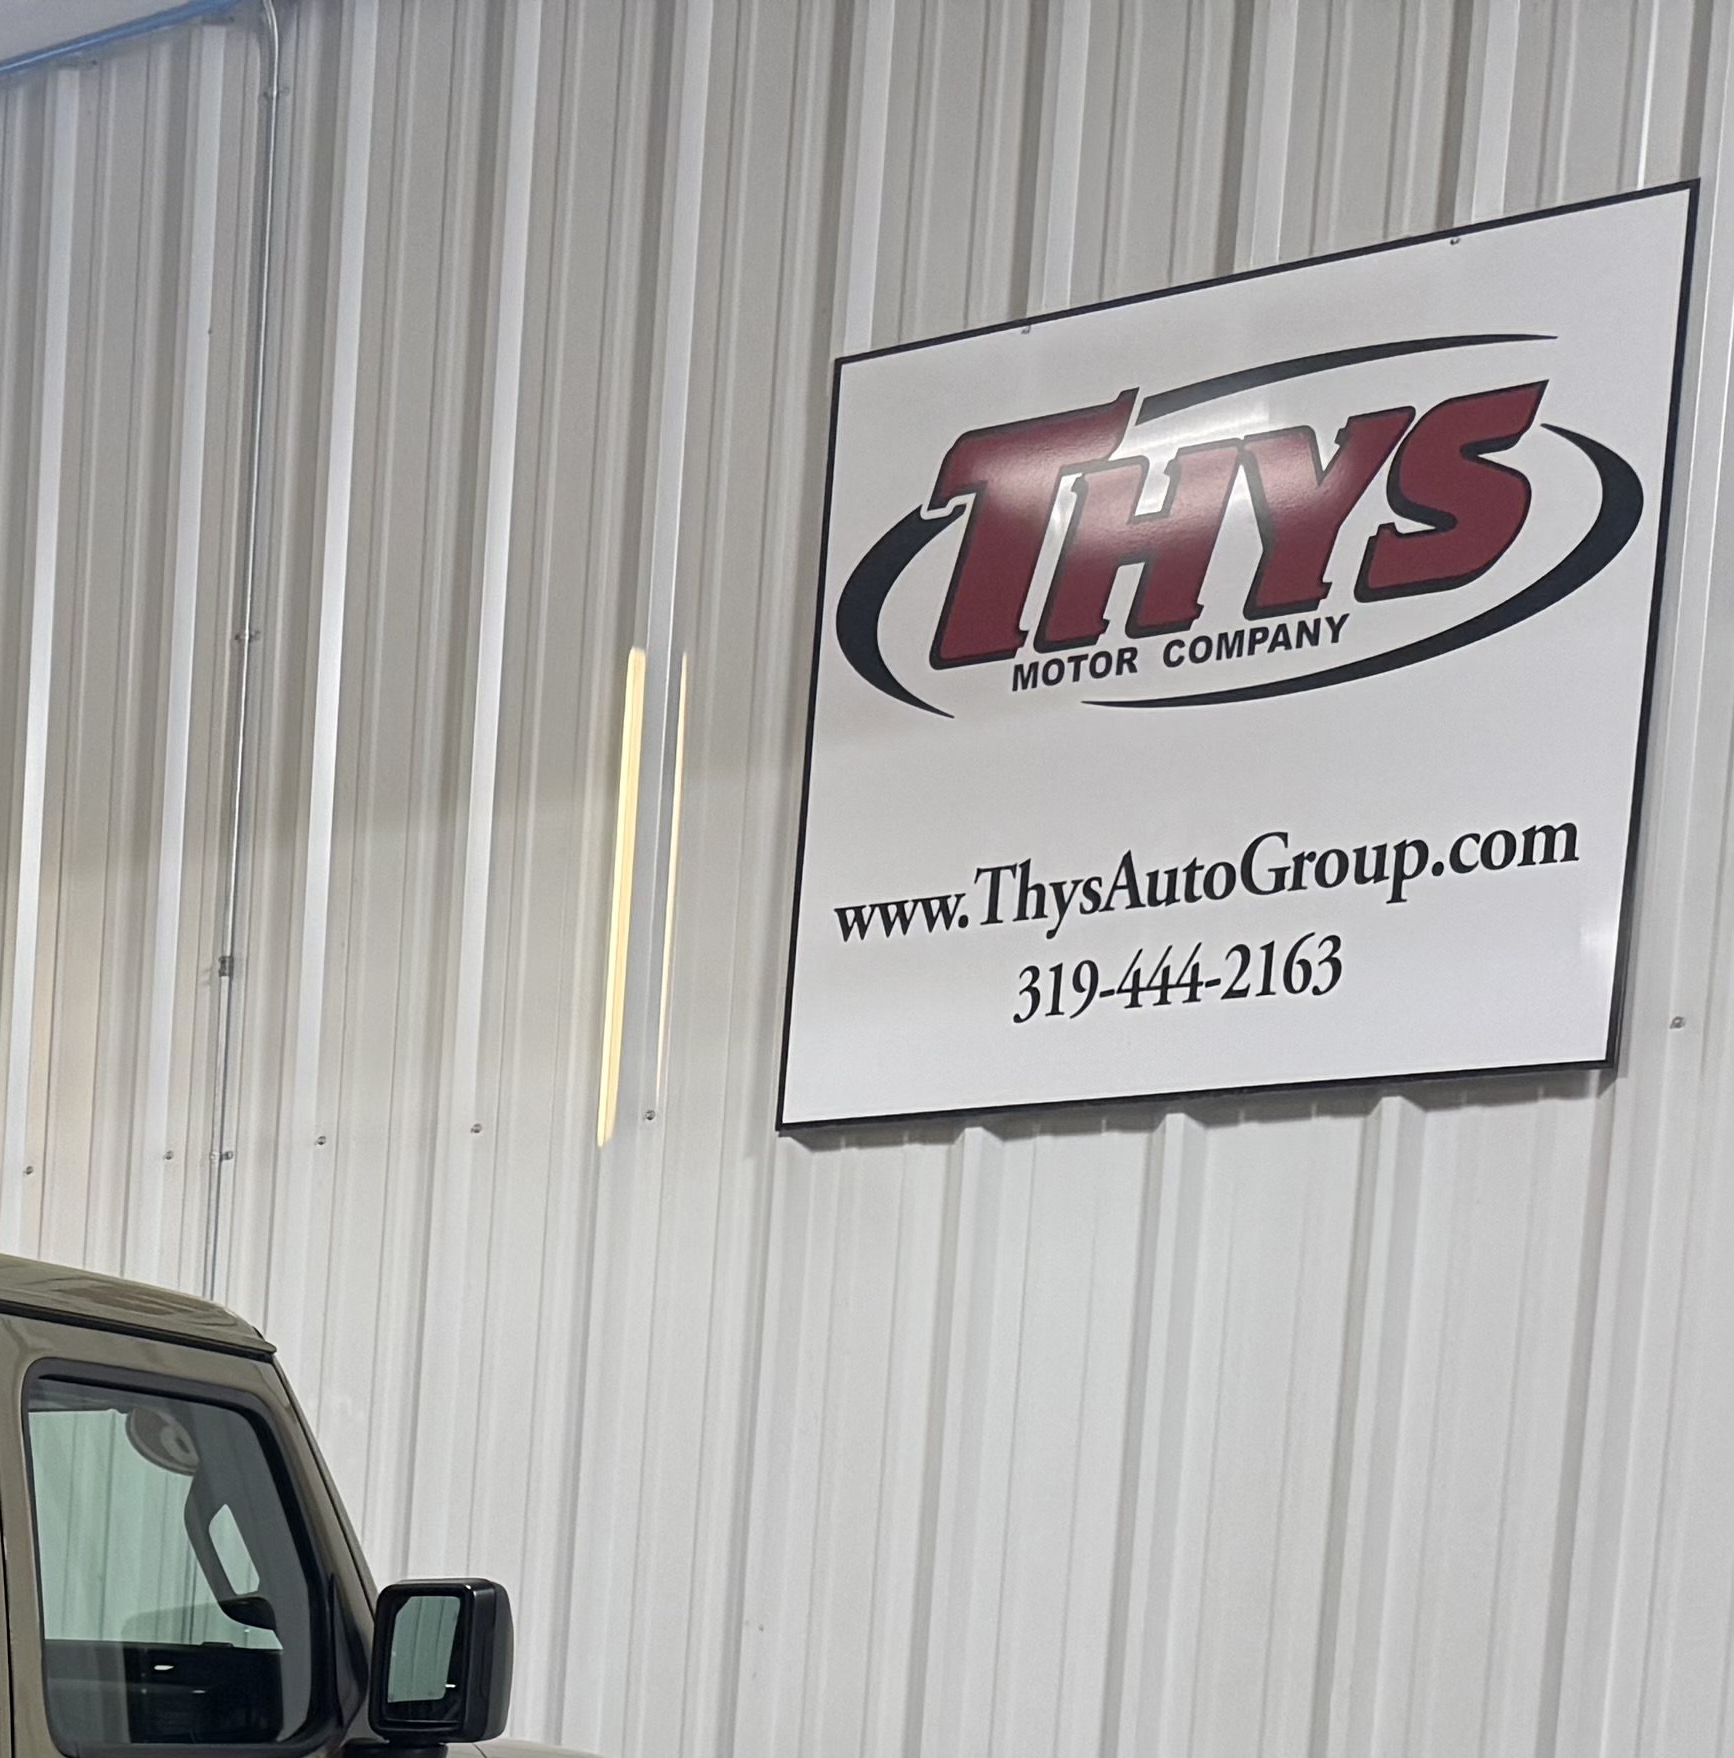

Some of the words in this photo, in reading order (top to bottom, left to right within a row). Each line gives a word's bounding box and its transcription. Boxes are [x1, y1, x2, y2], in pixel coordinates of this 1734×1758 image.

[926, 379, 1549, 672] THYS
[1011, 645, 1139, 693] MOTOR
[1163, 613, 1350, 669] COMPANY
[834, 816, 1579, 944] www.ThysAutoGroup.com
[1012, 933, 1344, 1025] 319-444-2163
